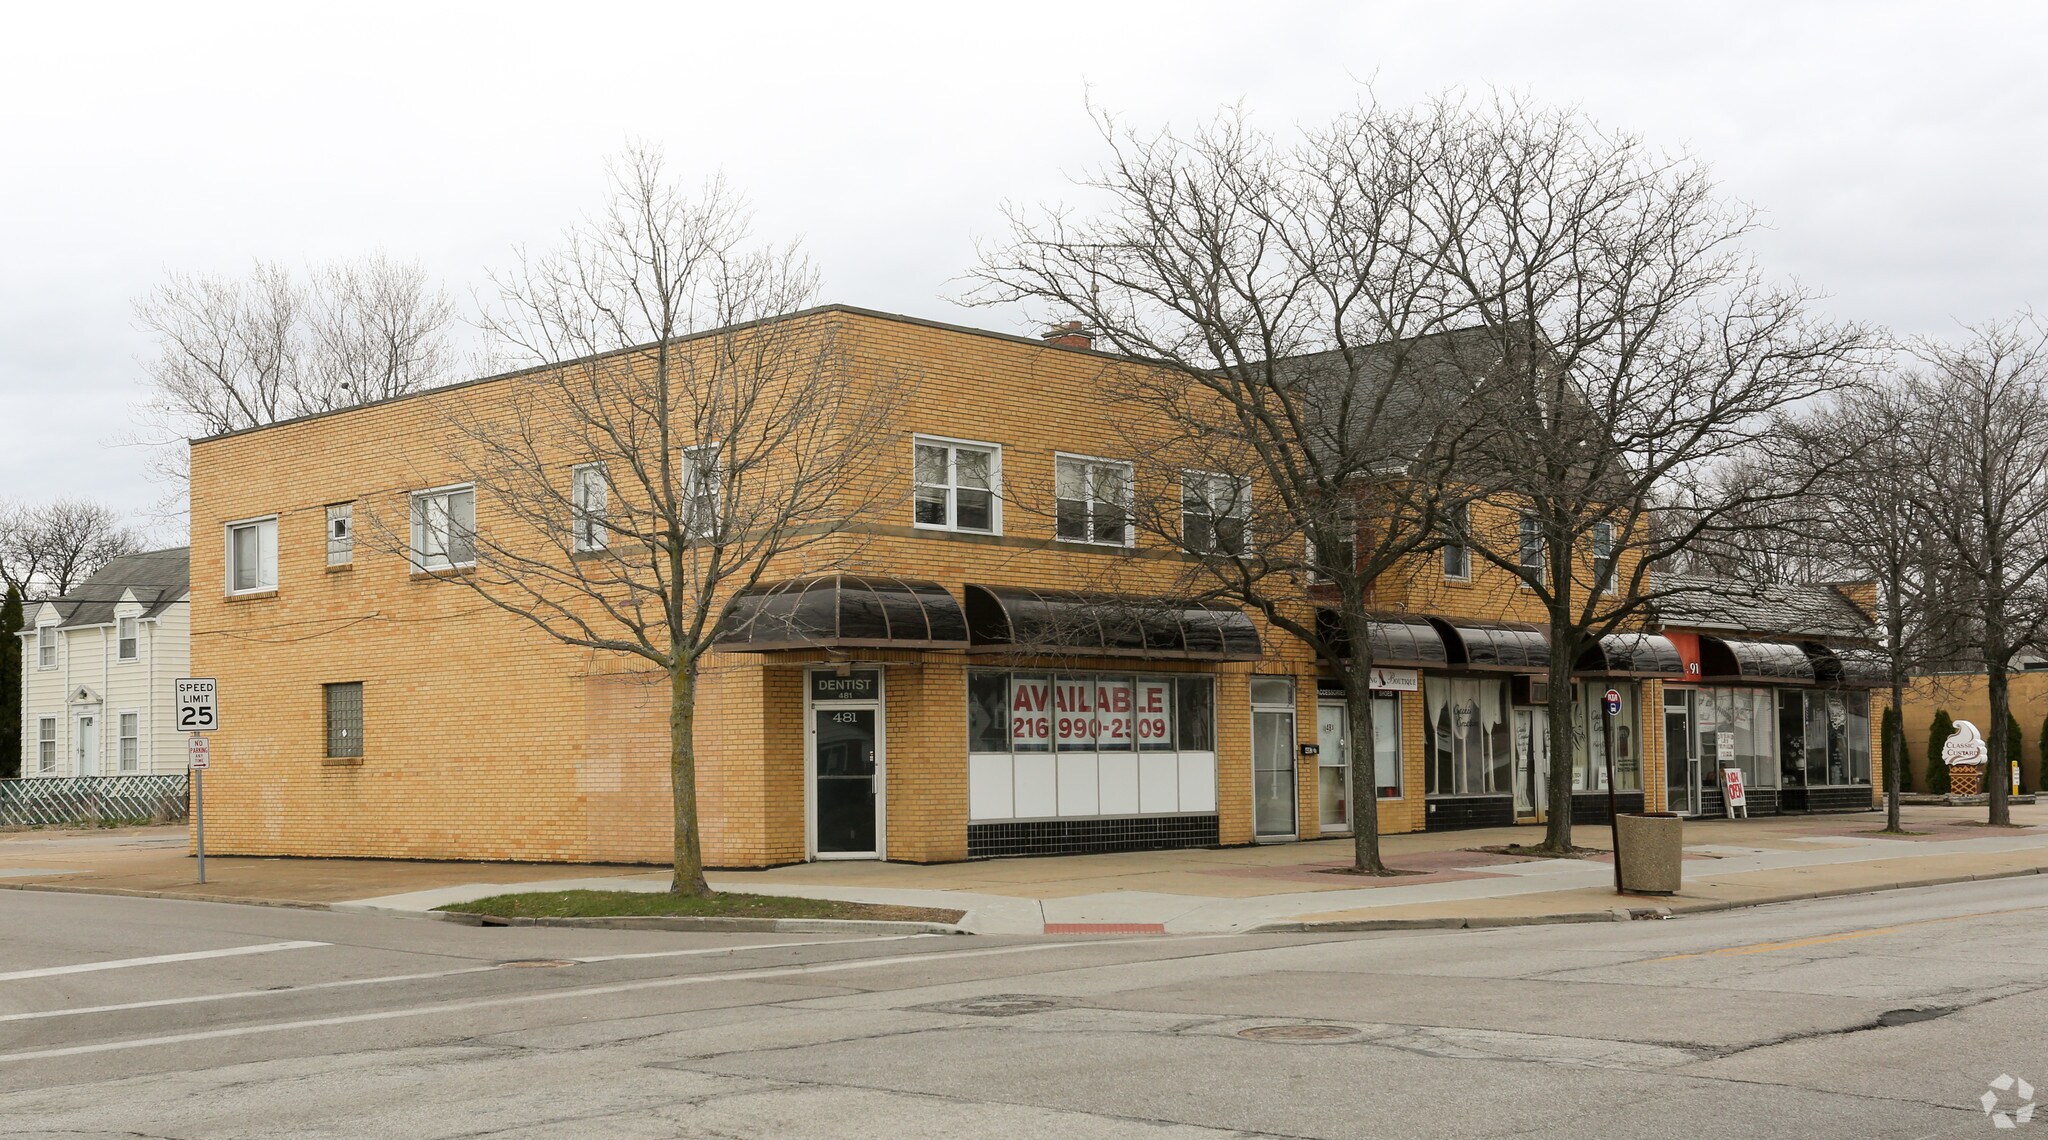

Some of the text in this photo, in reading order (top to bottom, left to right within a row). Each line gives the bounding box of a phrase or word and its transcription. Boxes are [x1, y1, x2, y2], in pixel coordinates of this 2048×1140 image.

[179, 683, 214, 692] SPEED
[818, 679, 872, 690] DENTIST
[183, 694, 210, 703] LIMIT
[1013, 684, 1163, 713] AVAILABE
[181, 706, 213, 726] 25
[832, 711, 858, 723] 481
[1013, 717, 1048, 739] 216
[1728, 783, 1743, 800] OPEN
